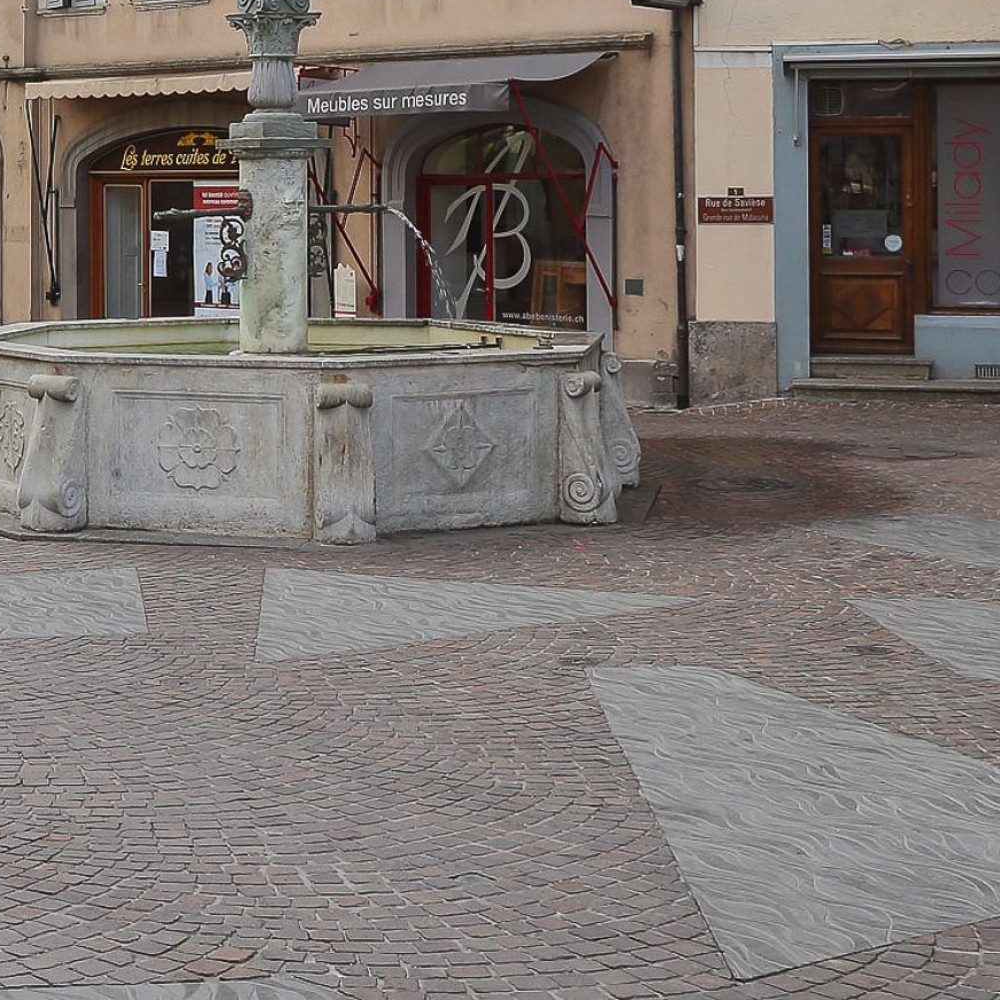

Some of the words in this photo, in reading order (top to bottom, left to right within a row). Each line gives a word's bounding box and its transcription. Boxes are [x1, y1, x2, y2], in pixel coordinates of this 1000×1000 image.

[307, 95, 369, 114] Meubles
[373, 97, 398, 110] sur
[401, 91, 467, 108] mesures
[140, 149, 173, 166] terres
[175, 147, 210, 166] cuites
[212, 148, 227, 165] de
[944, 116, 991, 259] Milady
[705, 199, 720, 207] Rue
[722, 199, 732, 207] de
